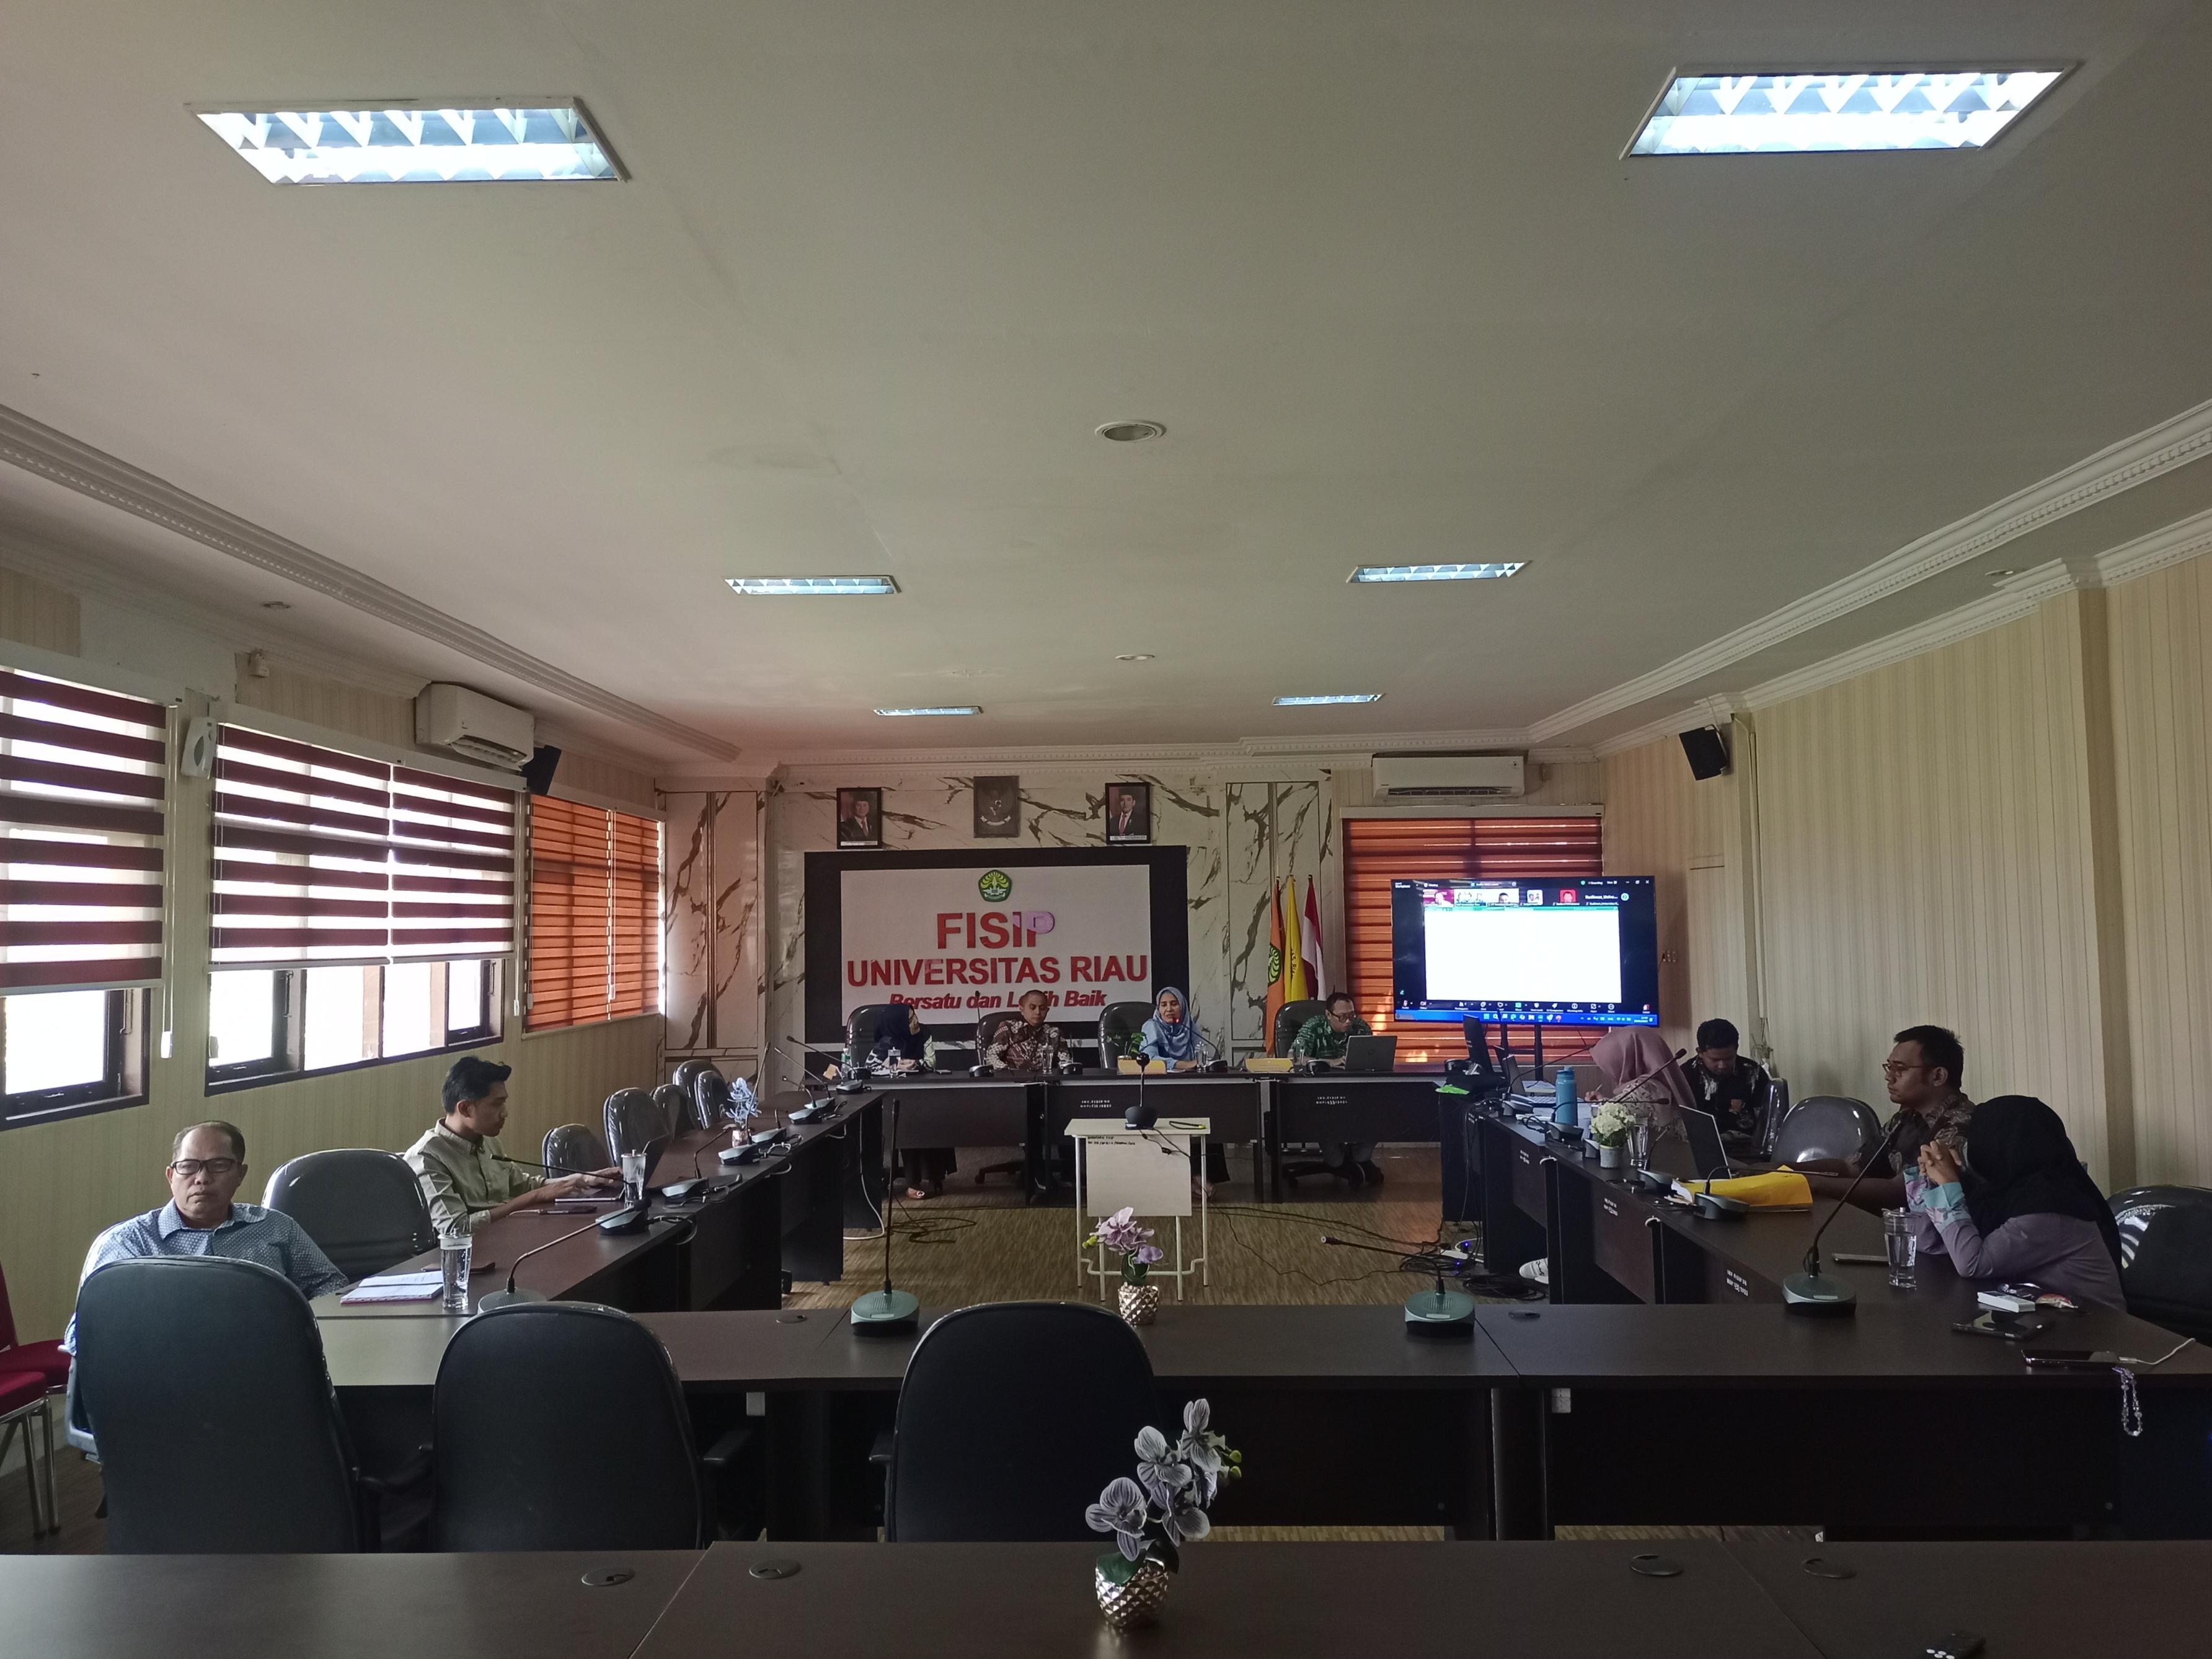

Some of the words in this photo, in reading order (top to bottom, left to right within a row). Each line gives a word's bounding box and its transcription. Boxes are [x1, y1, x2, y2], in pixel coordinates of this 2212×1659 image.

[937, 911, 1055, 949] FISIP
[847, 956, 1061, 987] UNIVERSITAS
[1070, 955, 1147, 982] RIAU
[890, 993, 962, 1009] Bersatu
[966, 992, 1001, 1009] dan
[1064, 990, 1107, 1007] Baik
